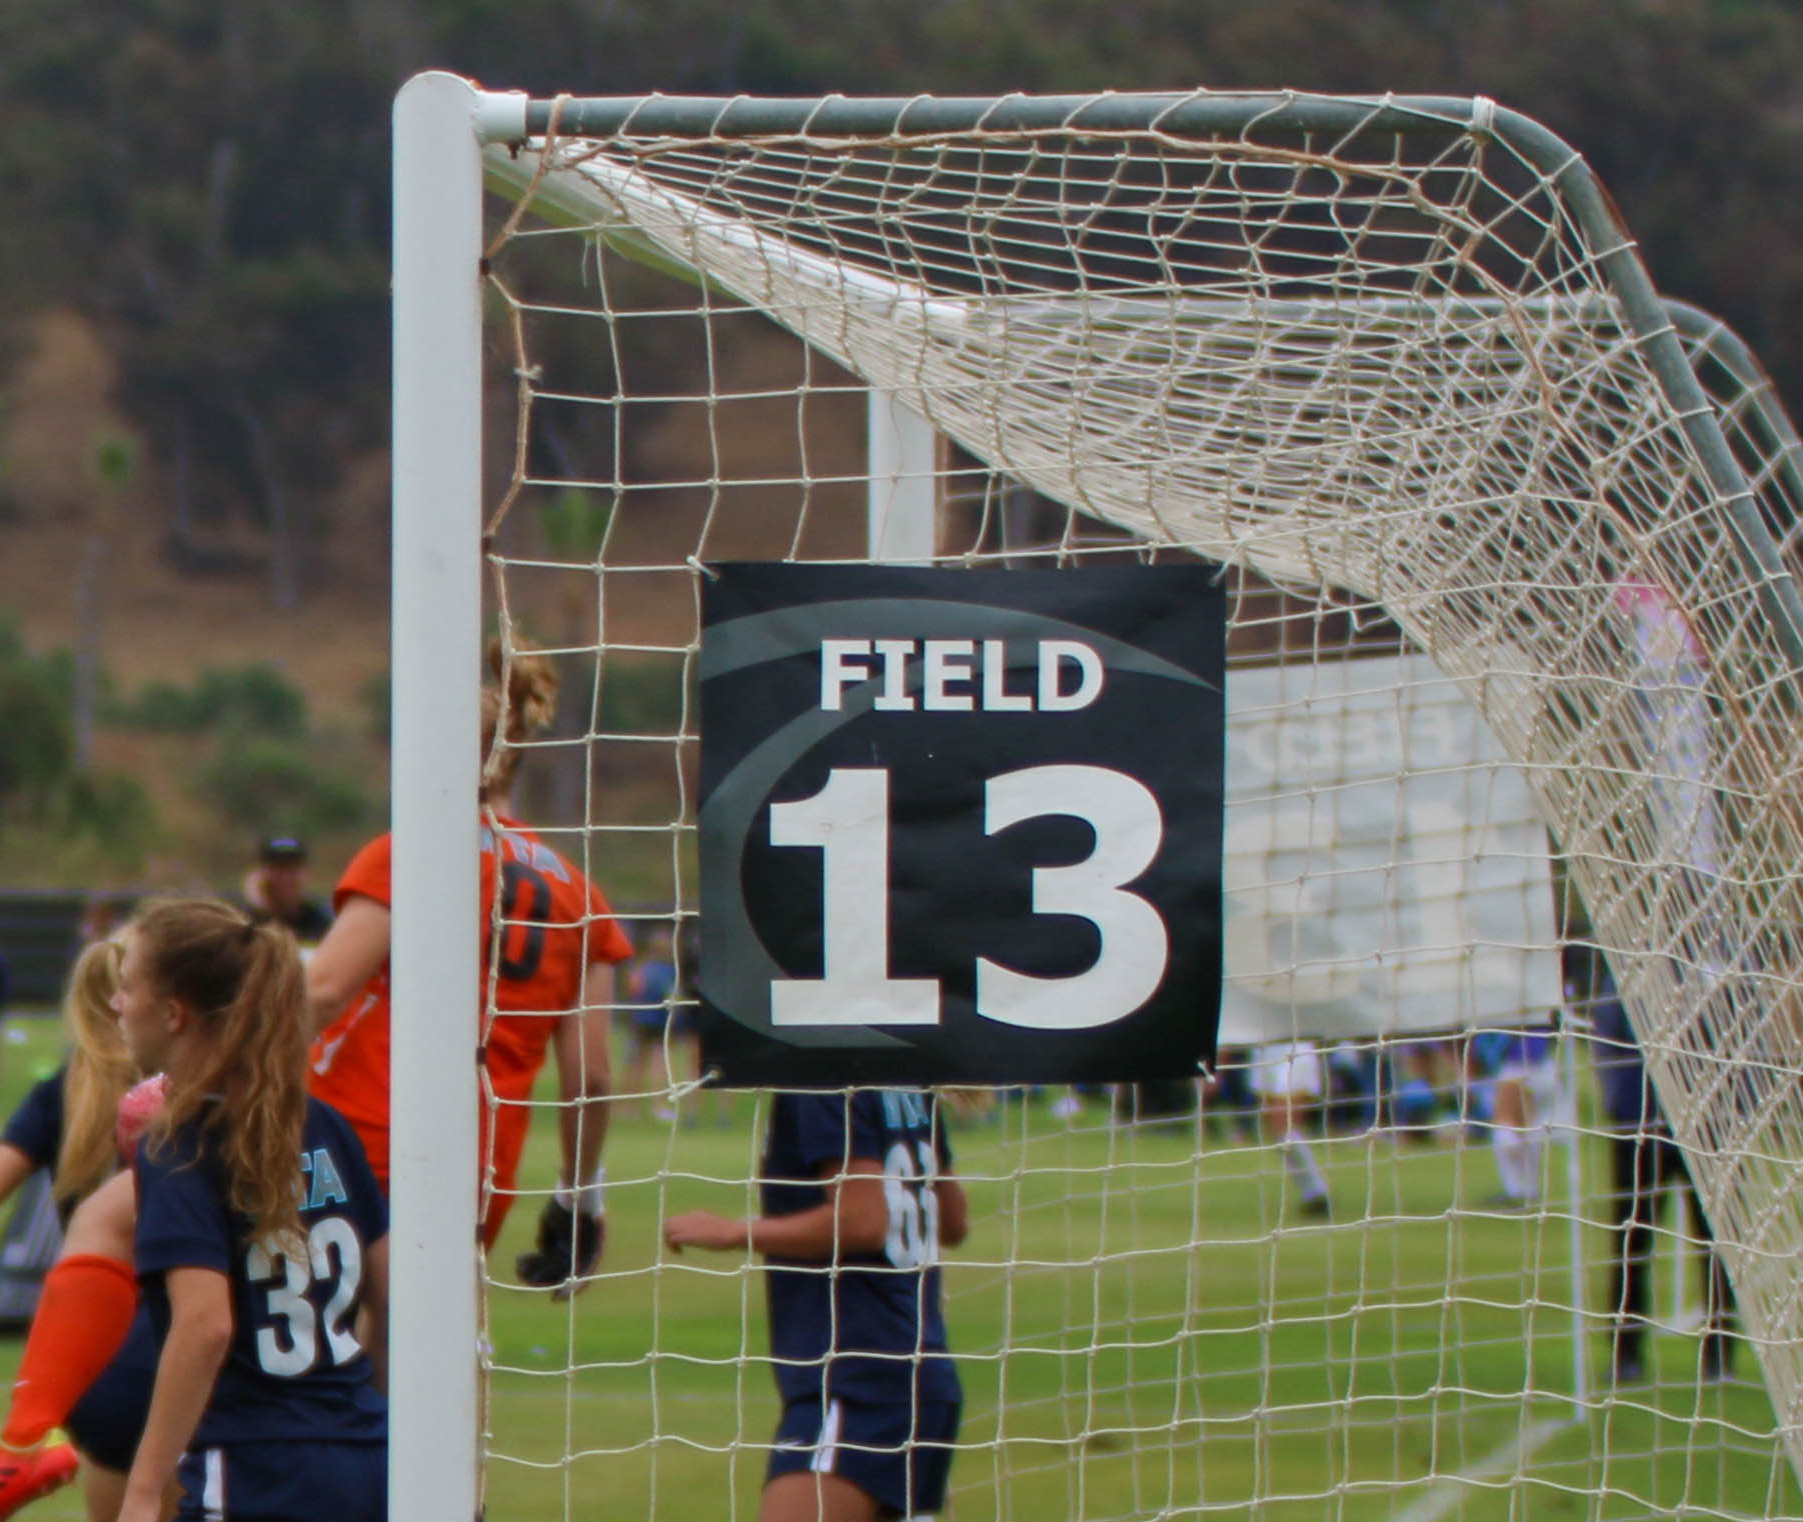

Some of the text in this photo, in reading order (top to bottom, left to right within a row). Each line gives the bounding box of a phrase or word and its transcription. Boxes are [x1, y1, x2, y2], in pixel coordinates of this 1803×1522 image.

[821, 639, 1104, 712] FIELD
[769, 765, 1169, 1029] 13
[246, 1216, 362, 1378] 32
